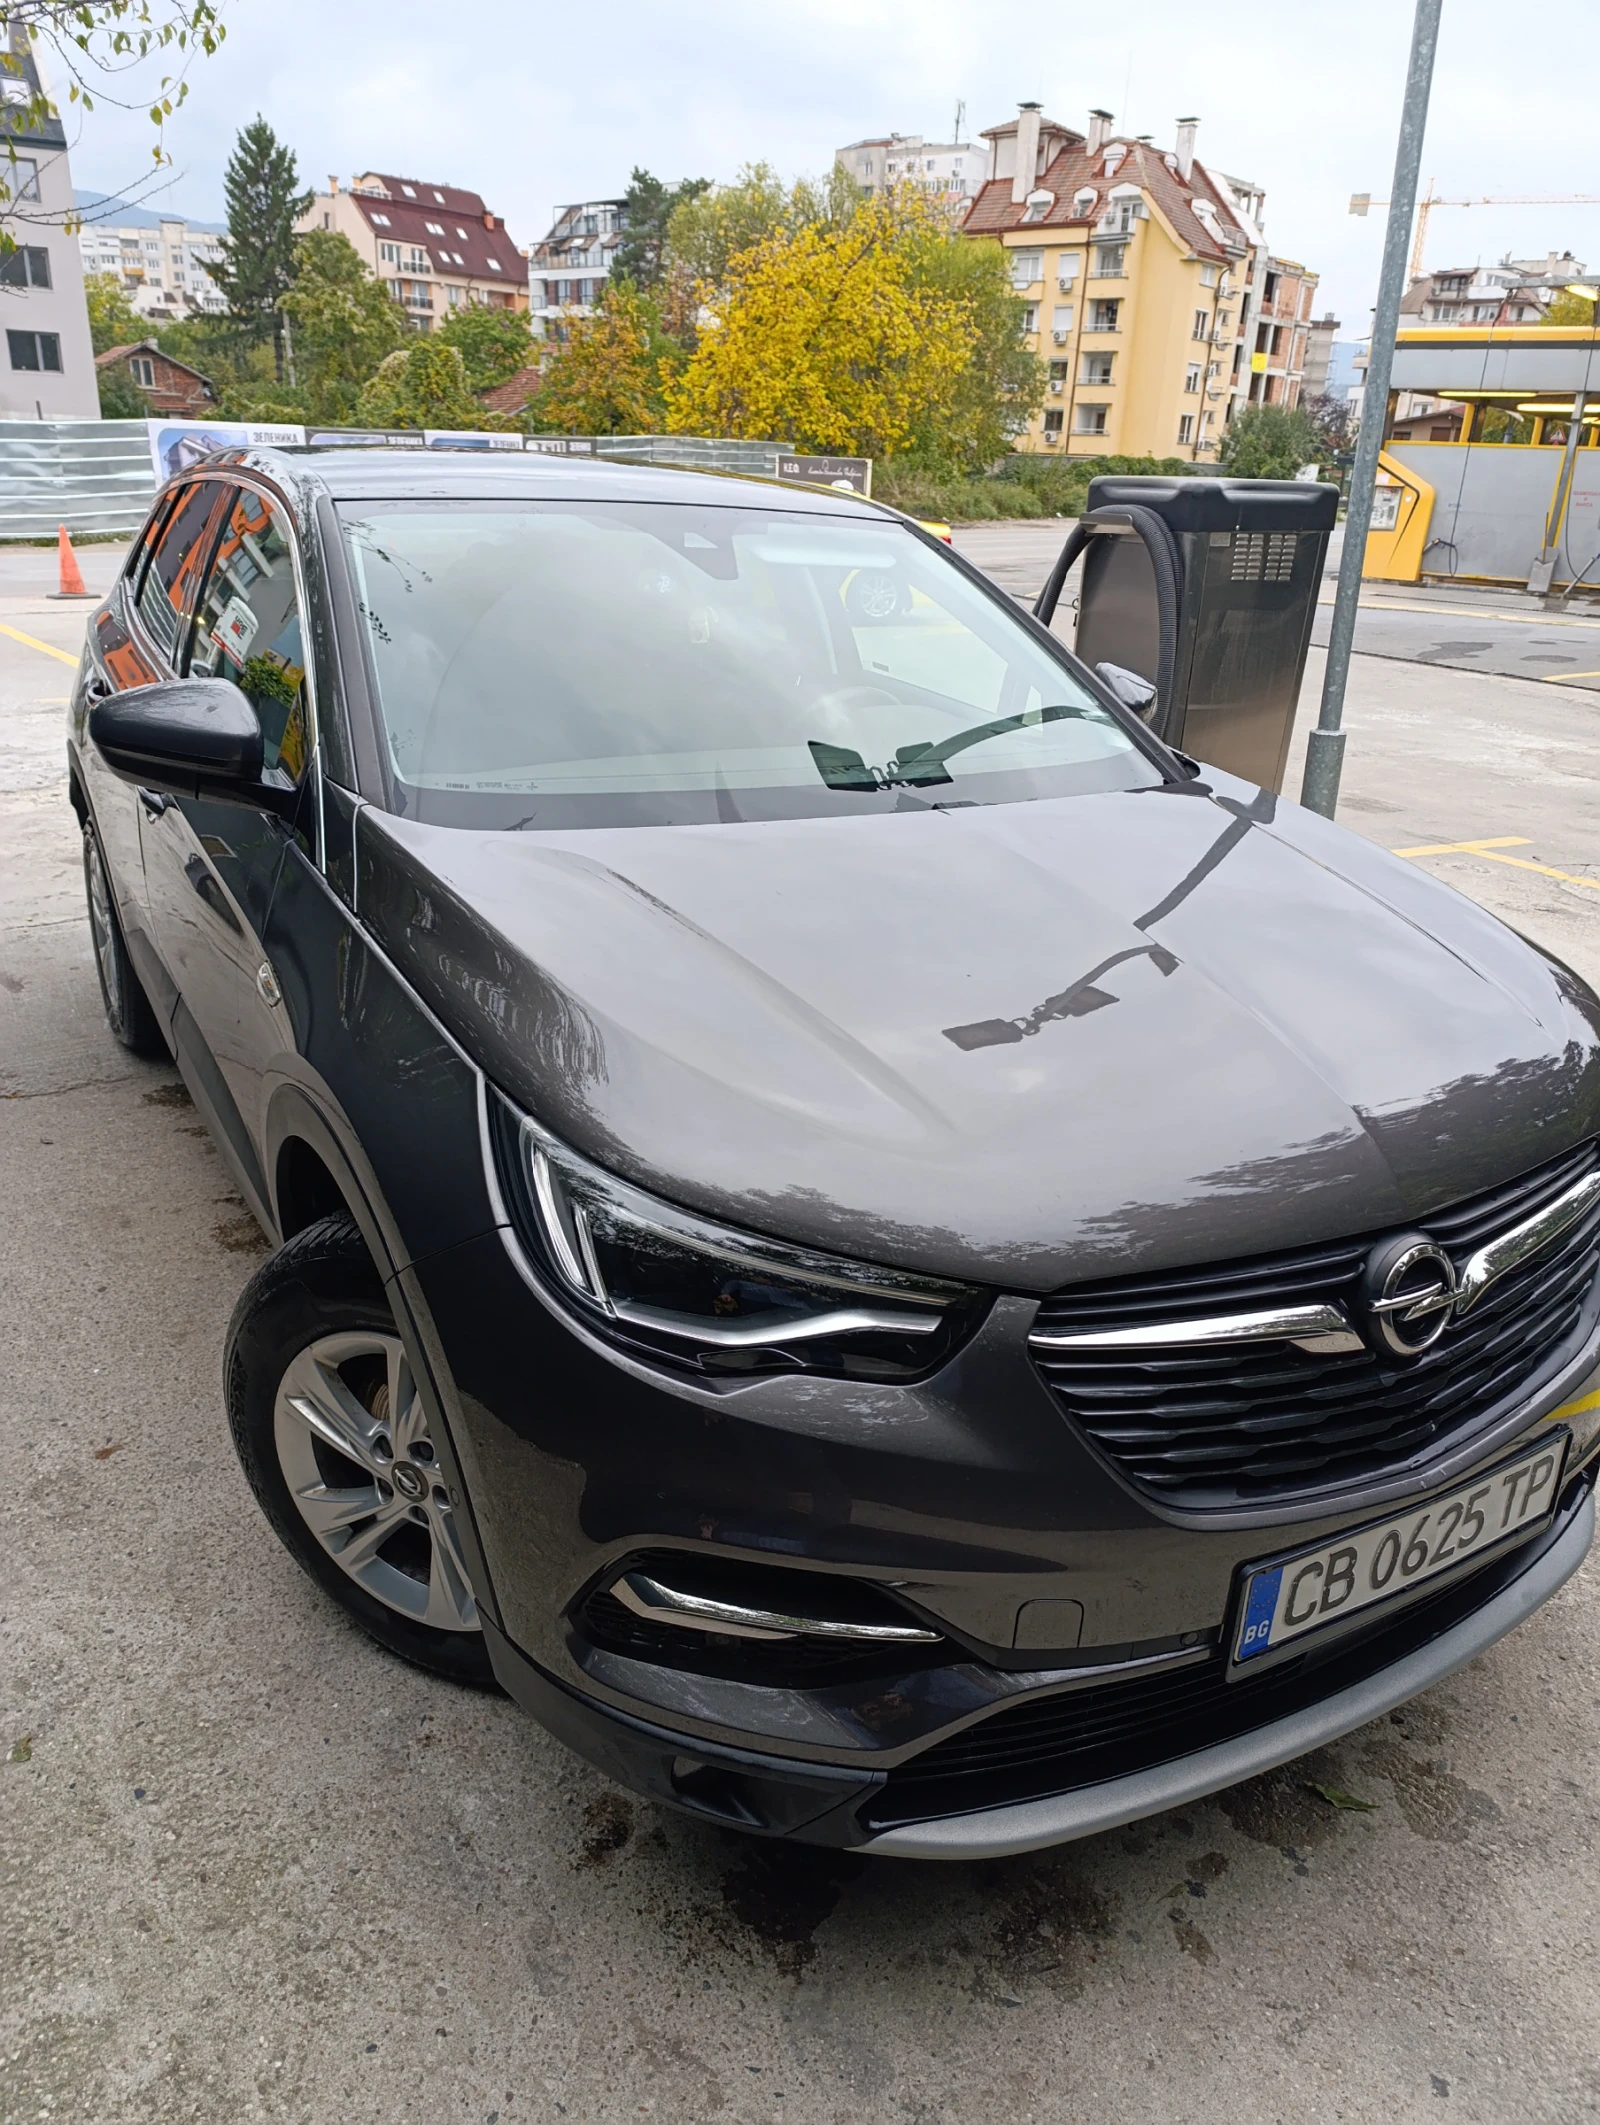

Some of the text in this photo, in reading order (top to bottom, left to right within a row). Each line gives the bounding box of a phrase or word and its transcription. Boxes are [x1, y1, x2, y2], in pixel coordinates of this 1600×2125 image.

[253, 431, 299, 444] ЗЕЛЕНИКА
[1284, 1454, 1555, 1627] CB 0625 TP
[1244, 1619, 1270, 1645] BG
